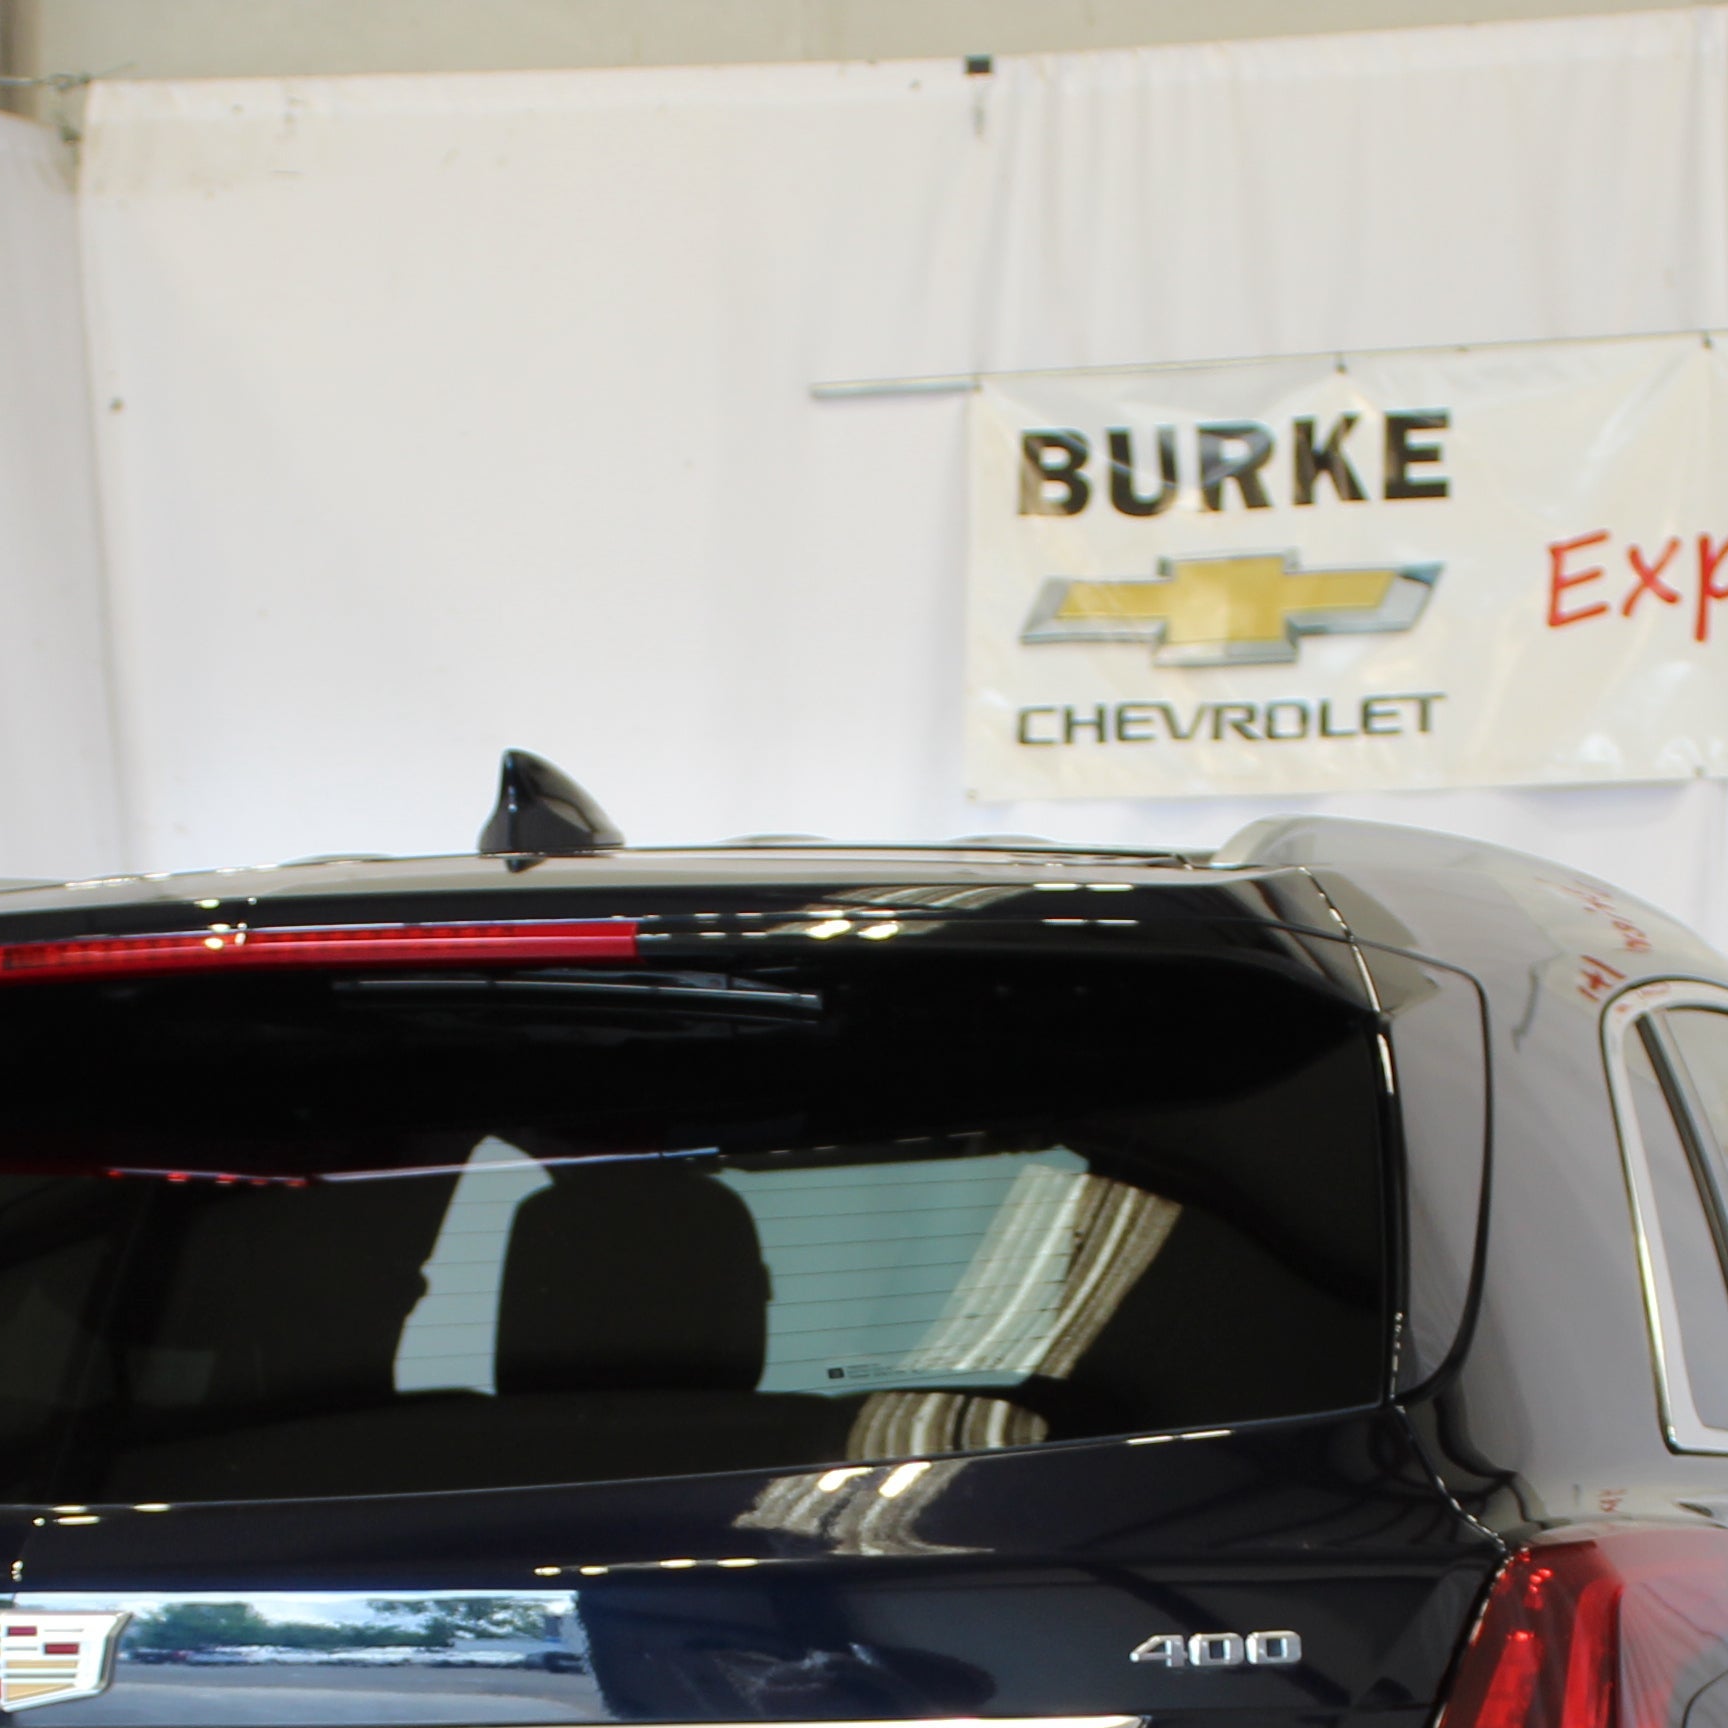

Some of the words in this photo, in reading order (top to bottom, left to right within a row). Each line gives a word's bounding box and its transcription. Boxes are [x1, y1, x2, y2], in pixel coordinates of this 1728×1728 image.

[1016, 407, 1453, 519] BURKE
[1016, 691, 1449, 747] CHEVROLET
[1129, 1629, 1303, 1668] 400
